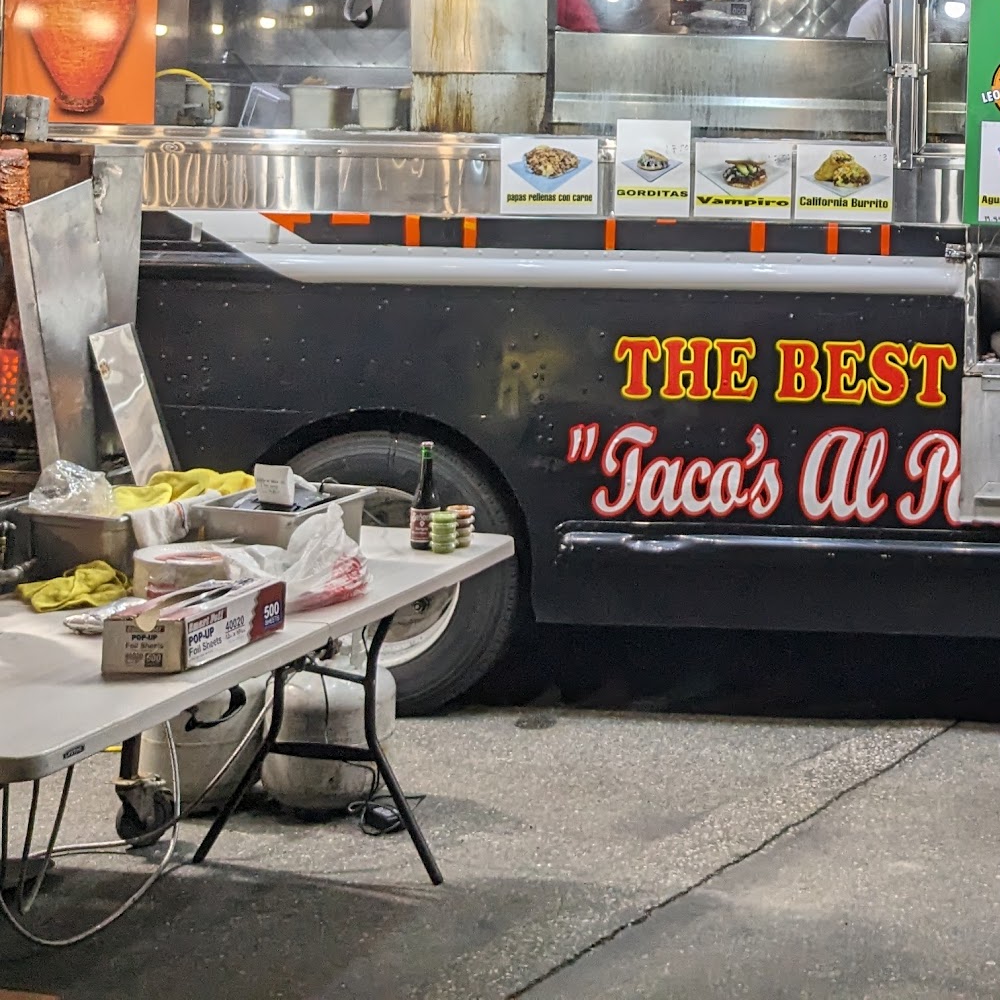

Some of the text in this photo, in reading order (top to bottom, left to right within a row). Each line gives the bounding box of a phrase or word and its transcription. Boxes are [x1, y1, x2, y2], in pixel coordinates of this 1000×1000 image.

[507, 193, 527, 202] papas
[528, 193, 556, 202] rellenas
[572, 194, 593, 202] carne
[617, 189, 688, 197] GORDITAS
[697, 196, 789, 207] Vampiro
[799, 197, 888, 208] California Burrito
[614, 335, 957, 407] THE BEST
[799, 425, 889, 523] Al
[264, 602, 280, 619] 500
[189, 627, 214, 646] POP-UP
[189, 637, 222, 657] Foil Sheets
